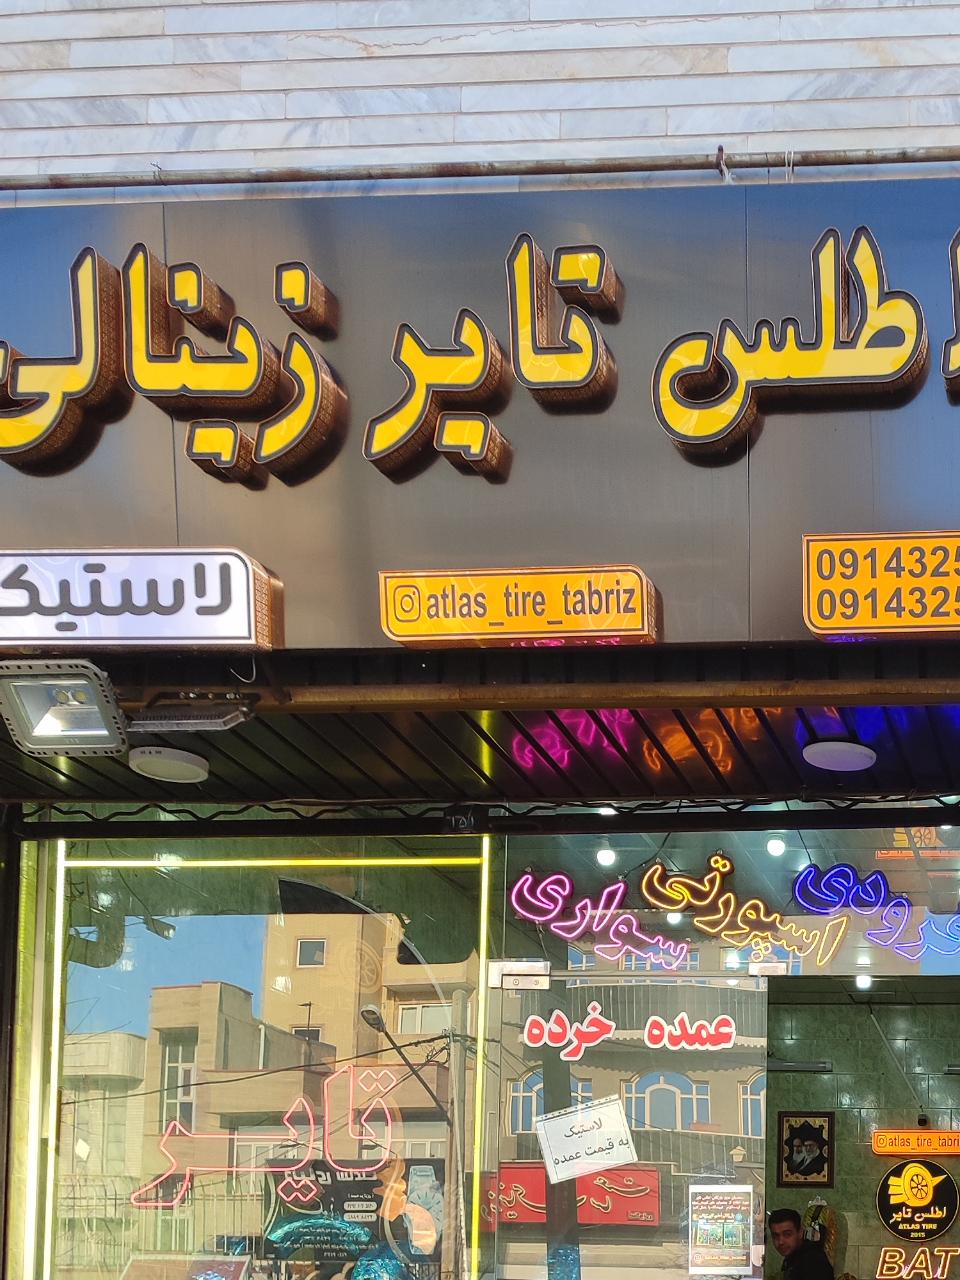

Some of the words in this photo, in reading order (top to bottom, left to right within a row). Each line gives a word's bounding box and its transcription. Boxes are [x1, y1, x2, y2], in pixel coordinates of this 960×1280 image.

[362, 232, 606, 463] تایر
[426, 581, 637, 627] atlas_tire_tabriz
[511, 874, 688, 970] سواری
[523, 1001, 616, 1061] خرده
[643, 1011, 737, 1051] عمده
[563, 1117, 603, 1139] لاستیک
[553, 1151, 582, 1166] عمده
[584, 1138, 615, 1156] قیمت
[914, 1206, 947, 1221] اطلس
[876, 1247, 960, 1280] BAT
